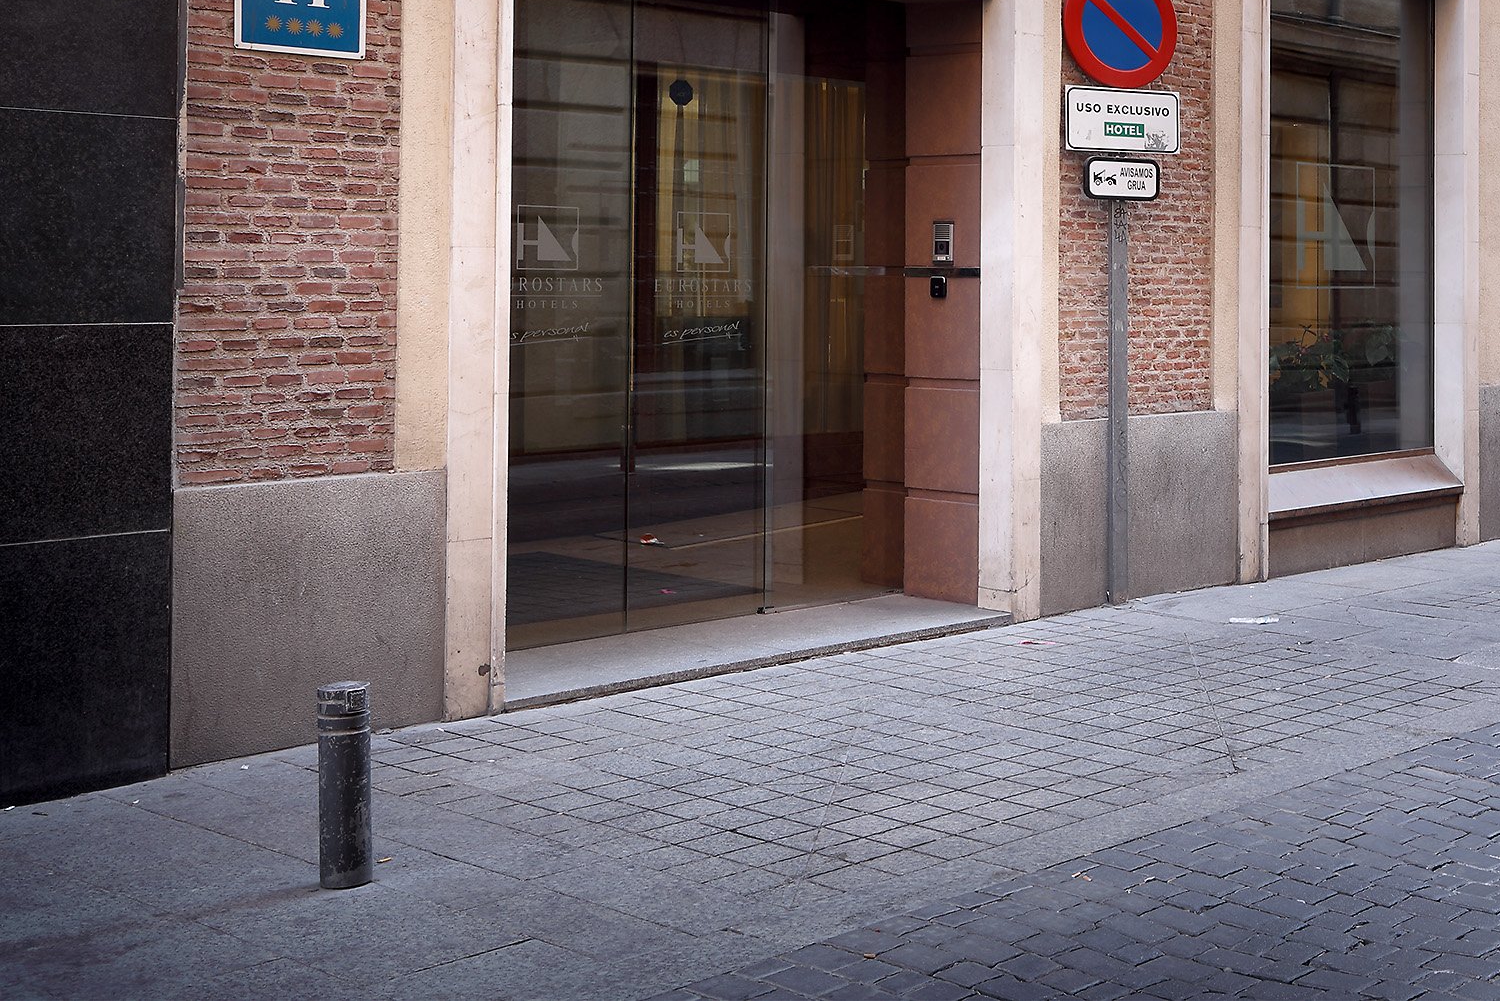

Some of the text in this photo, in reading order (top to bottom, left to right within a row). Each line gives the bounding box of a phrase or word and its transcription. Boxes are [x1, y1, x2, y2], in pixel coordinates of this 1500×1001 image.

[1076, 102, 1170, 117] USO EXCLUSIVO
[1105, 124, 1143, 136] HOTEL
[1119, 167, 1154, 179] AVISAMOS
[1127, 180, 1147, 191] GRUA
[654, 278, 752, 292] EUROSTARS
[516, 299, 579, 309] HOTELS
[519, 321, 590, 341] personal
[663, 320, 741, 341] es personal
